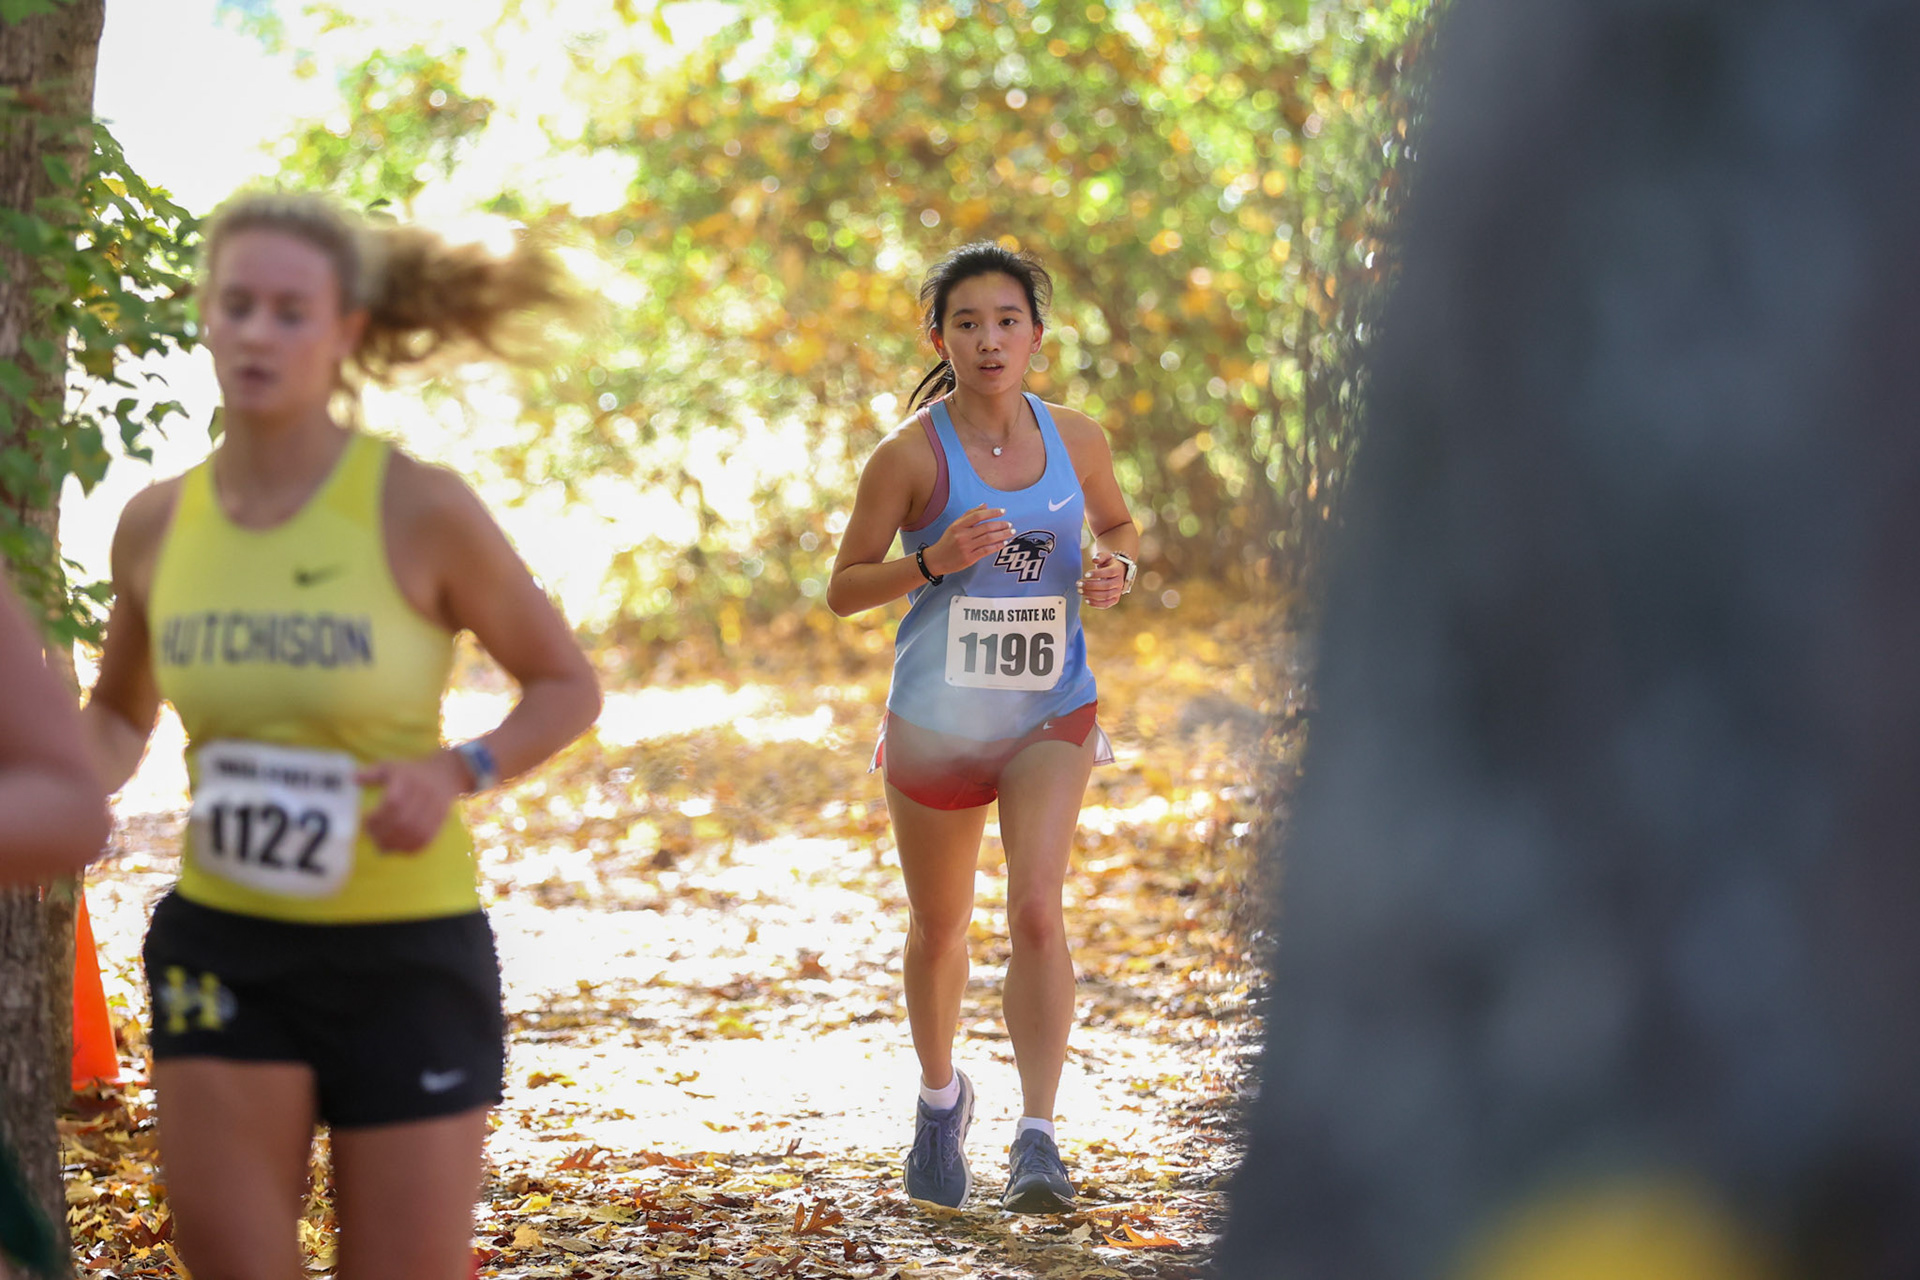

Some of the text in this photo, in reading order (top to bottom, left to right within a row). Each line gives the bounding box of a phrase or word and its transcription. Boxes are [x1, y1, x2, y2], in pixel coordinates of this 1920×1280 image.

[996, 543, 1043, 582] SBA
[963, 607, 1056, 622] TMSAA STATE XC
[958, 632, 1054, 677] 1196
[208, 801, 330, 877] 1122
